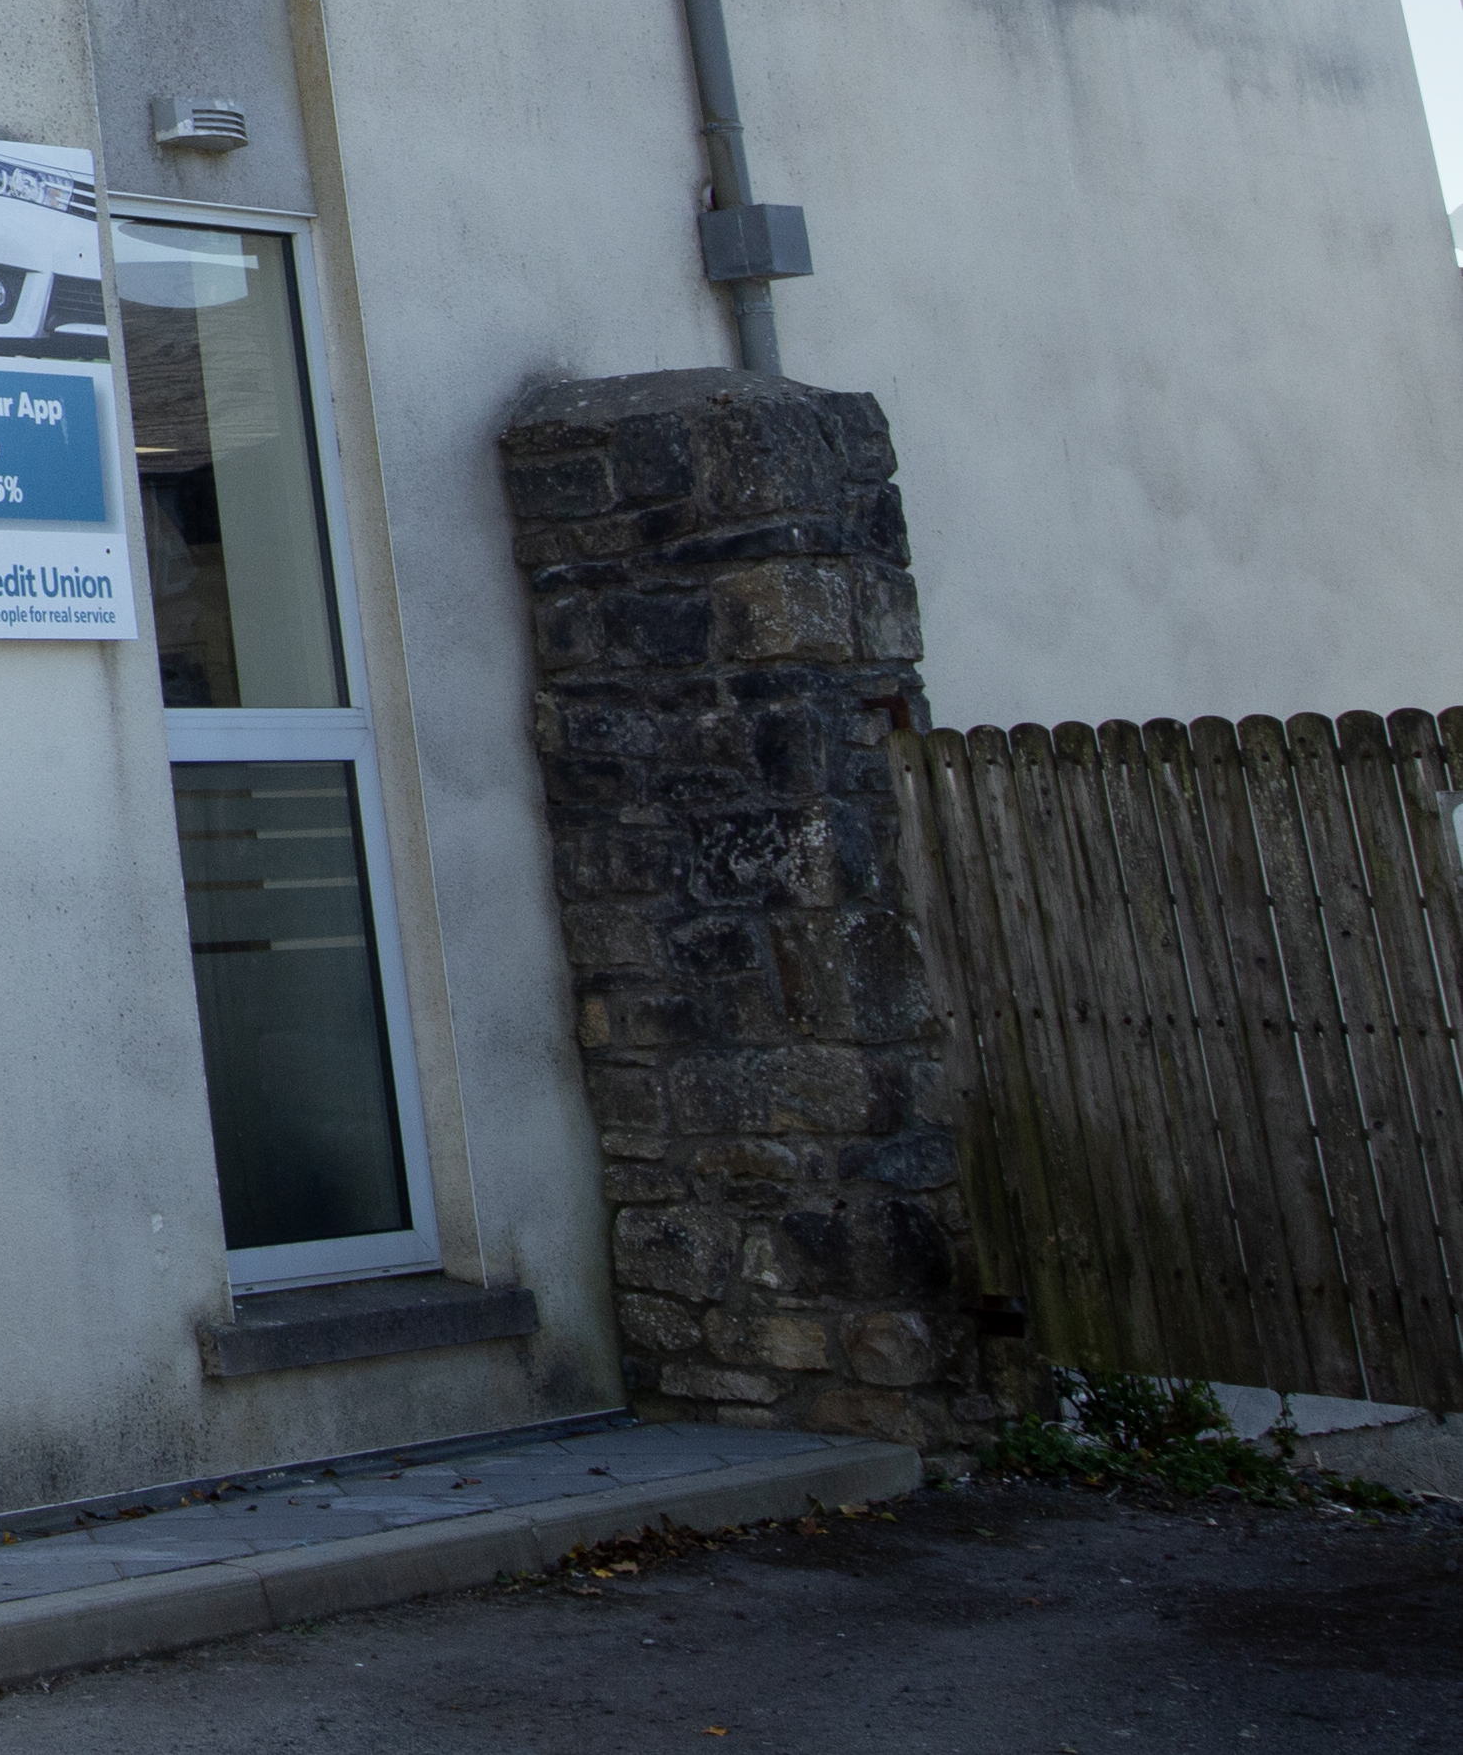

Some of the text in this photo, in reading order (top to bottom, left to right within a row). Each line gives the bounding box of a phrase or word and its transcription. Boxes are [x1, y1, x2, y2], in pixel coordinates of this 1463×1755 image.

[17, 391, 64, 426] App
[40, 566, 113, 599] Union
[29, 607, 49, 623] for
[49, 607, 72, 624] real
[74, 606, 116, 624] service
